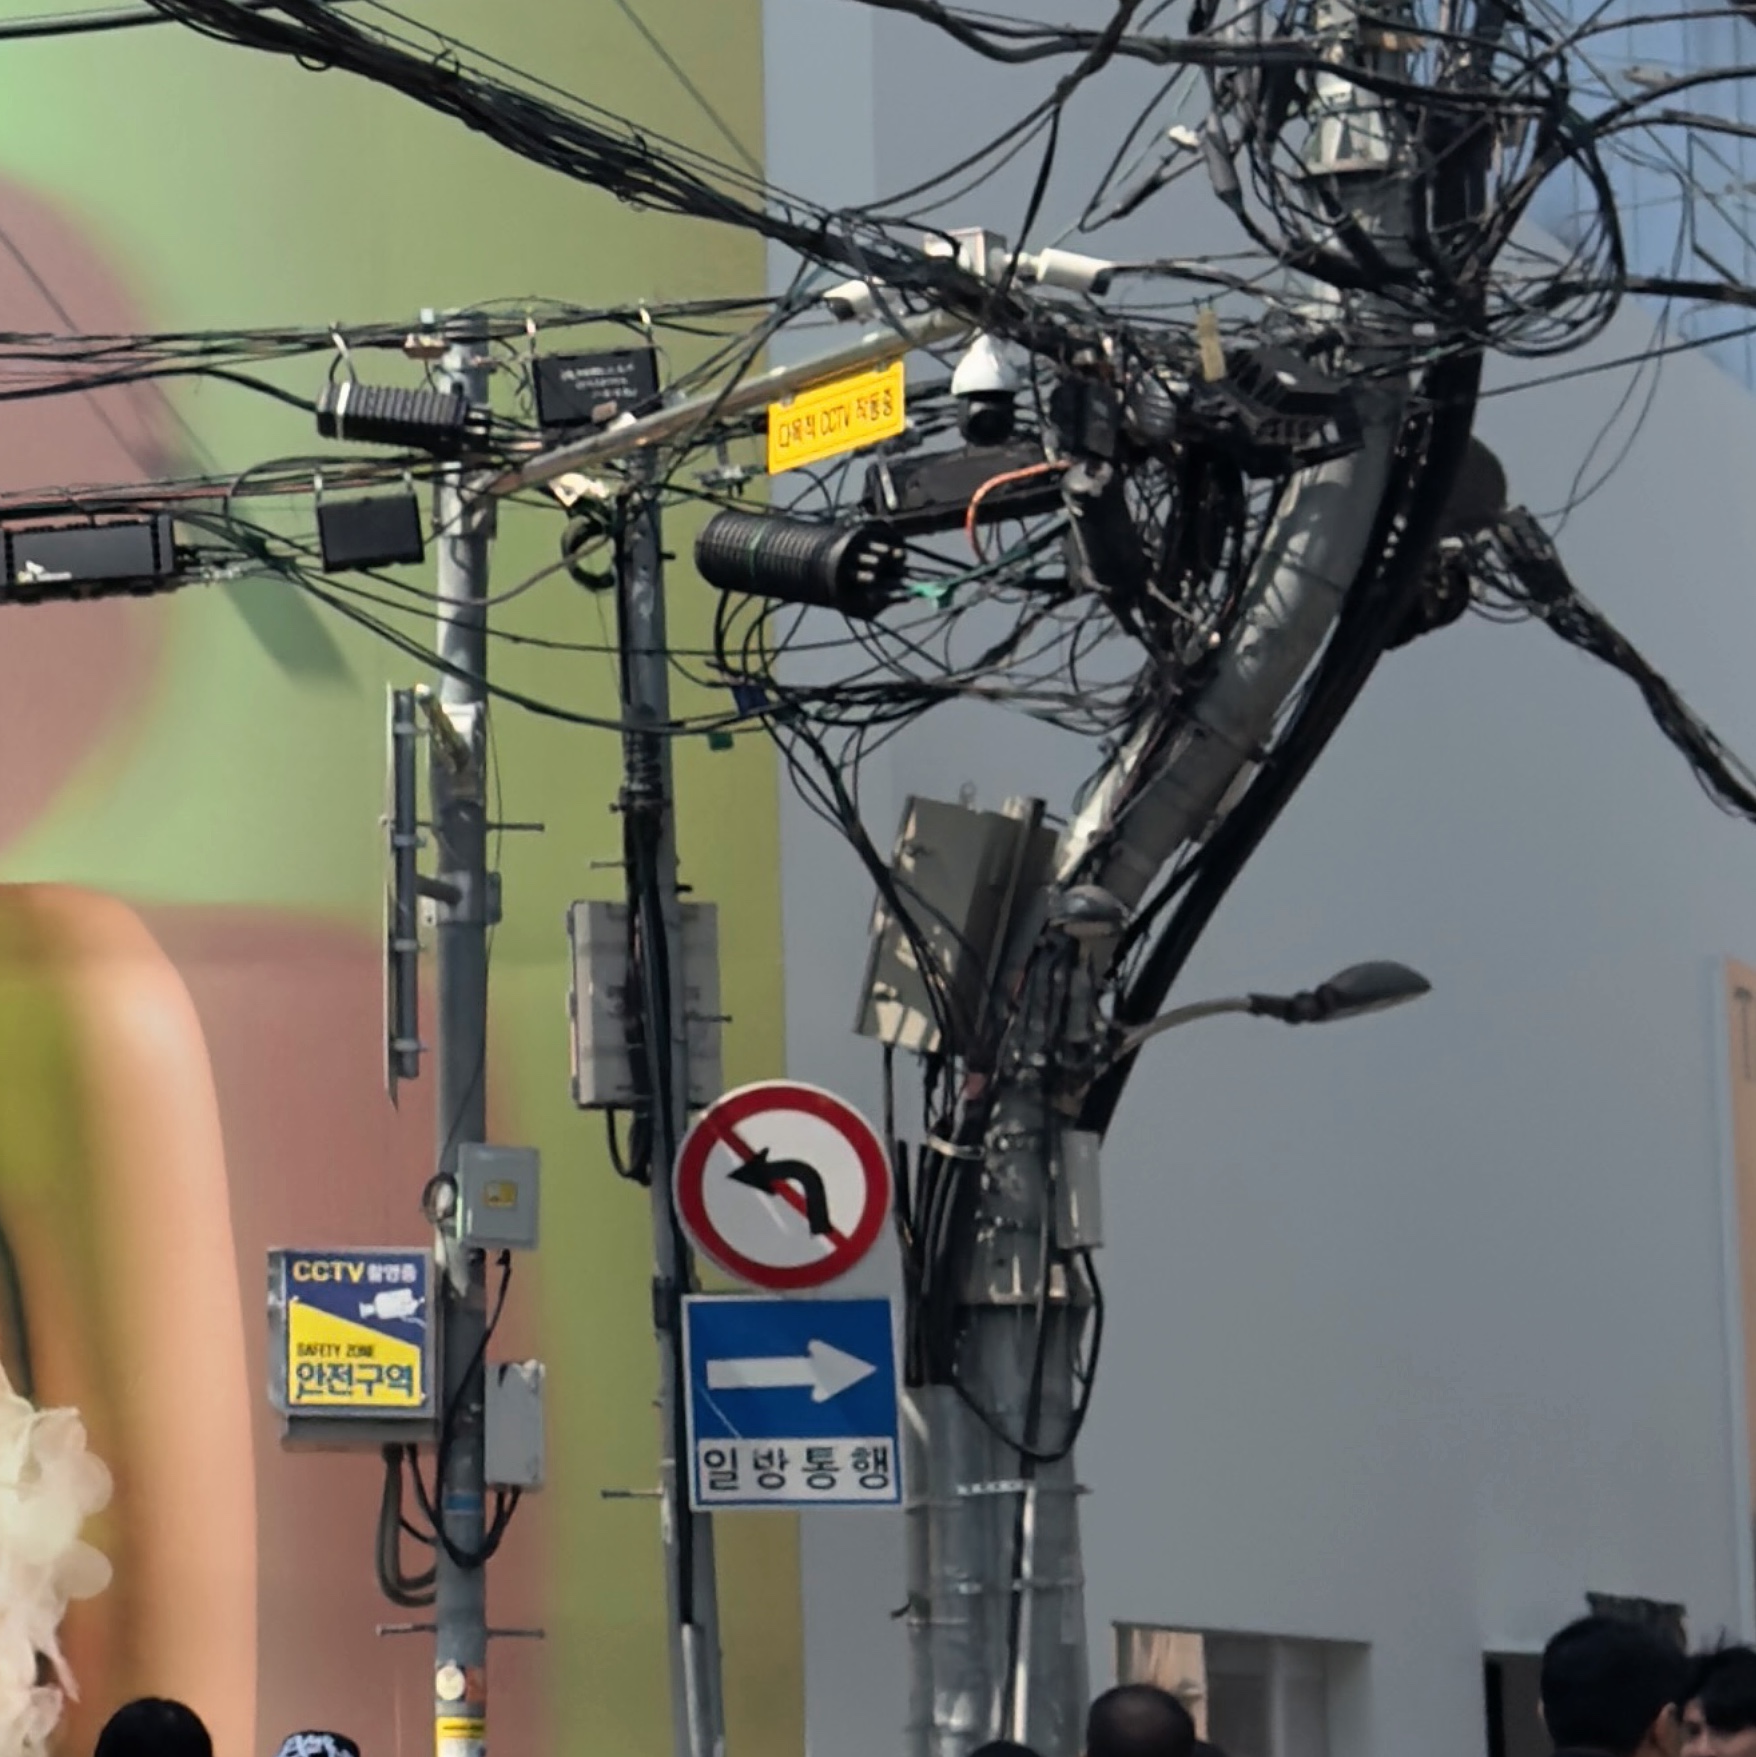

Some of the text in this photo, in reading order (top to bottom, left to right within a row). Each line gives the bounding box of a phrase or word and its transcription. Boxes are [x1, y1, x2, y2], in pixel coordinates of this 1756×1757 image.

[820, 404, 850, 436] CCTV
[292, 1260, 365, 1283] CCTV
[297, 1342, 374, 1358] SAFETY ZONE
[296, 1363, 414, 1399] 안전구역
[703, 1446, 889, 1491] 일방통행
